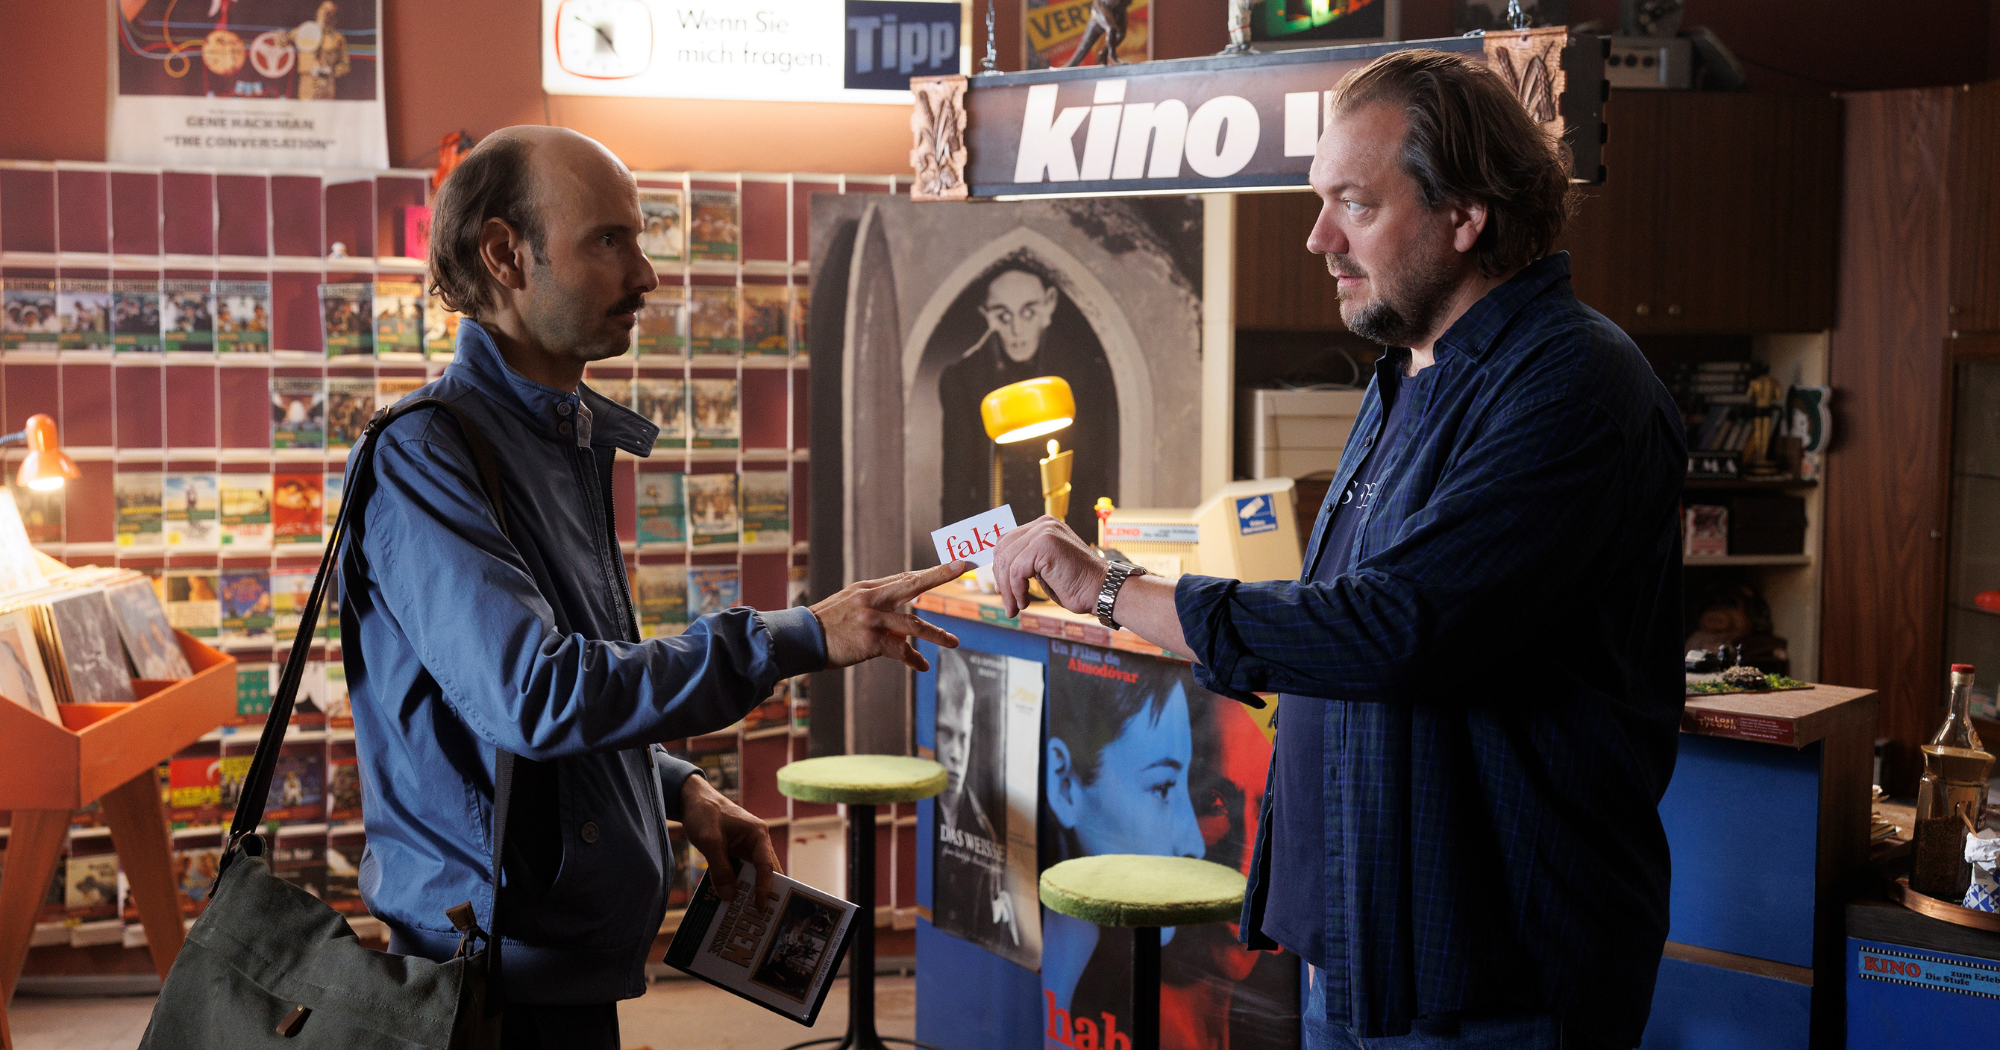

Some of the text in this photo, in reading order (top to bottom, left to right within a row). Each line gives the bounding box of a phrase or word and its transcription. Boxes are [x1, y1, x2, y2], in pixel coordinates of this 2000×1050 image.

[678, 9, 788, 33] Wenn Sie
[678, 41, 733, 63] mich
[848, 14, 955, 74] Tipp
[187, 116, 314, 130] GENE HACKMAN
[1013, 79, 1260, 183] kino
[946, 523, 1004, 561] fakt
[1051, 639, 1120, 666] Un Film de
[1068, 658, 1139, 684] Almodóvar
[1698, 718, 1737, 730] Tycoon
[1715, 715, 1734, 724] Last
[940, 824, 964, 847] DAS
[831, 936, 840, 949] Film
[821, 959, 830, 973] Mike
[1864, 956, 1921, 977] KINO
[1951, 970, 1972, 980] zum
[1925, 972, 1970, 986] Die Stufe
[1044, 988, 1131, 1050] hab
